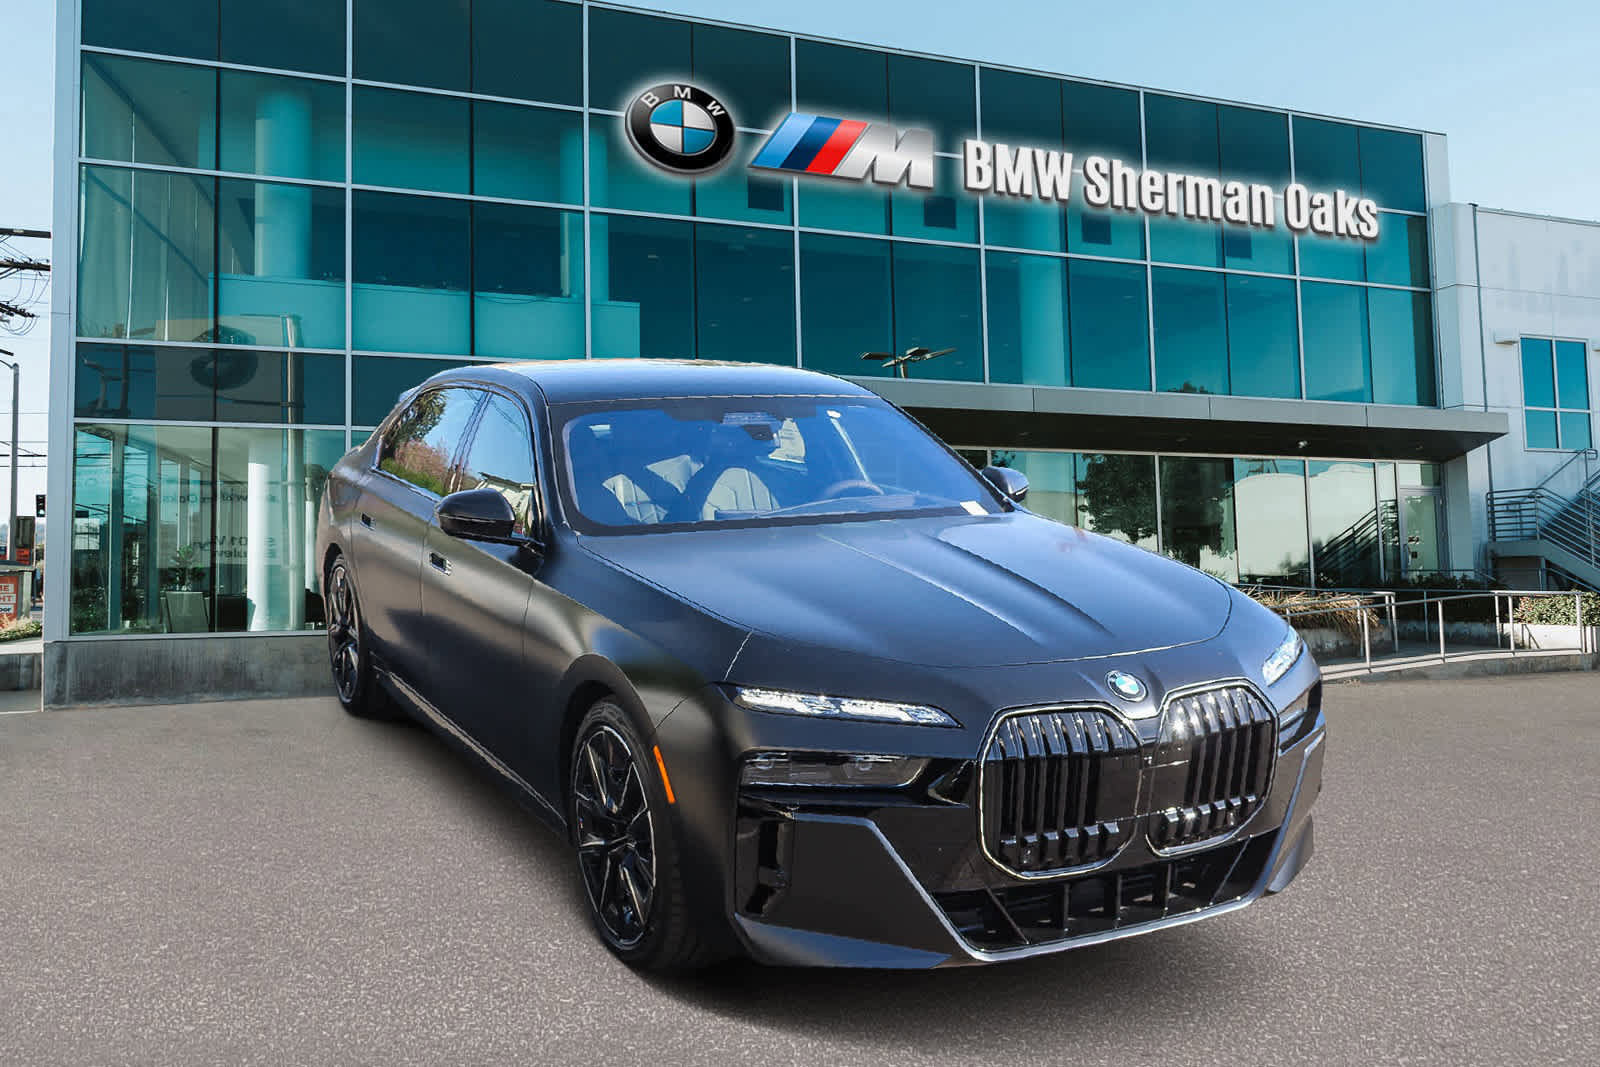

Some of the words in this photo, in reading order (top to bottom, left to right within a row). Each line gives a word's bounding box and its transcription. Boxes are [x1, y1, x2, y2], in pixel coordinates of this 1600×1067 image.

[640, 85, 726, 118] BMW
[964, 138, 1073, 203] BMW
[1084, 156, 1275, 228] Sherman
[1285, 182, 1380, 240] Oaks
